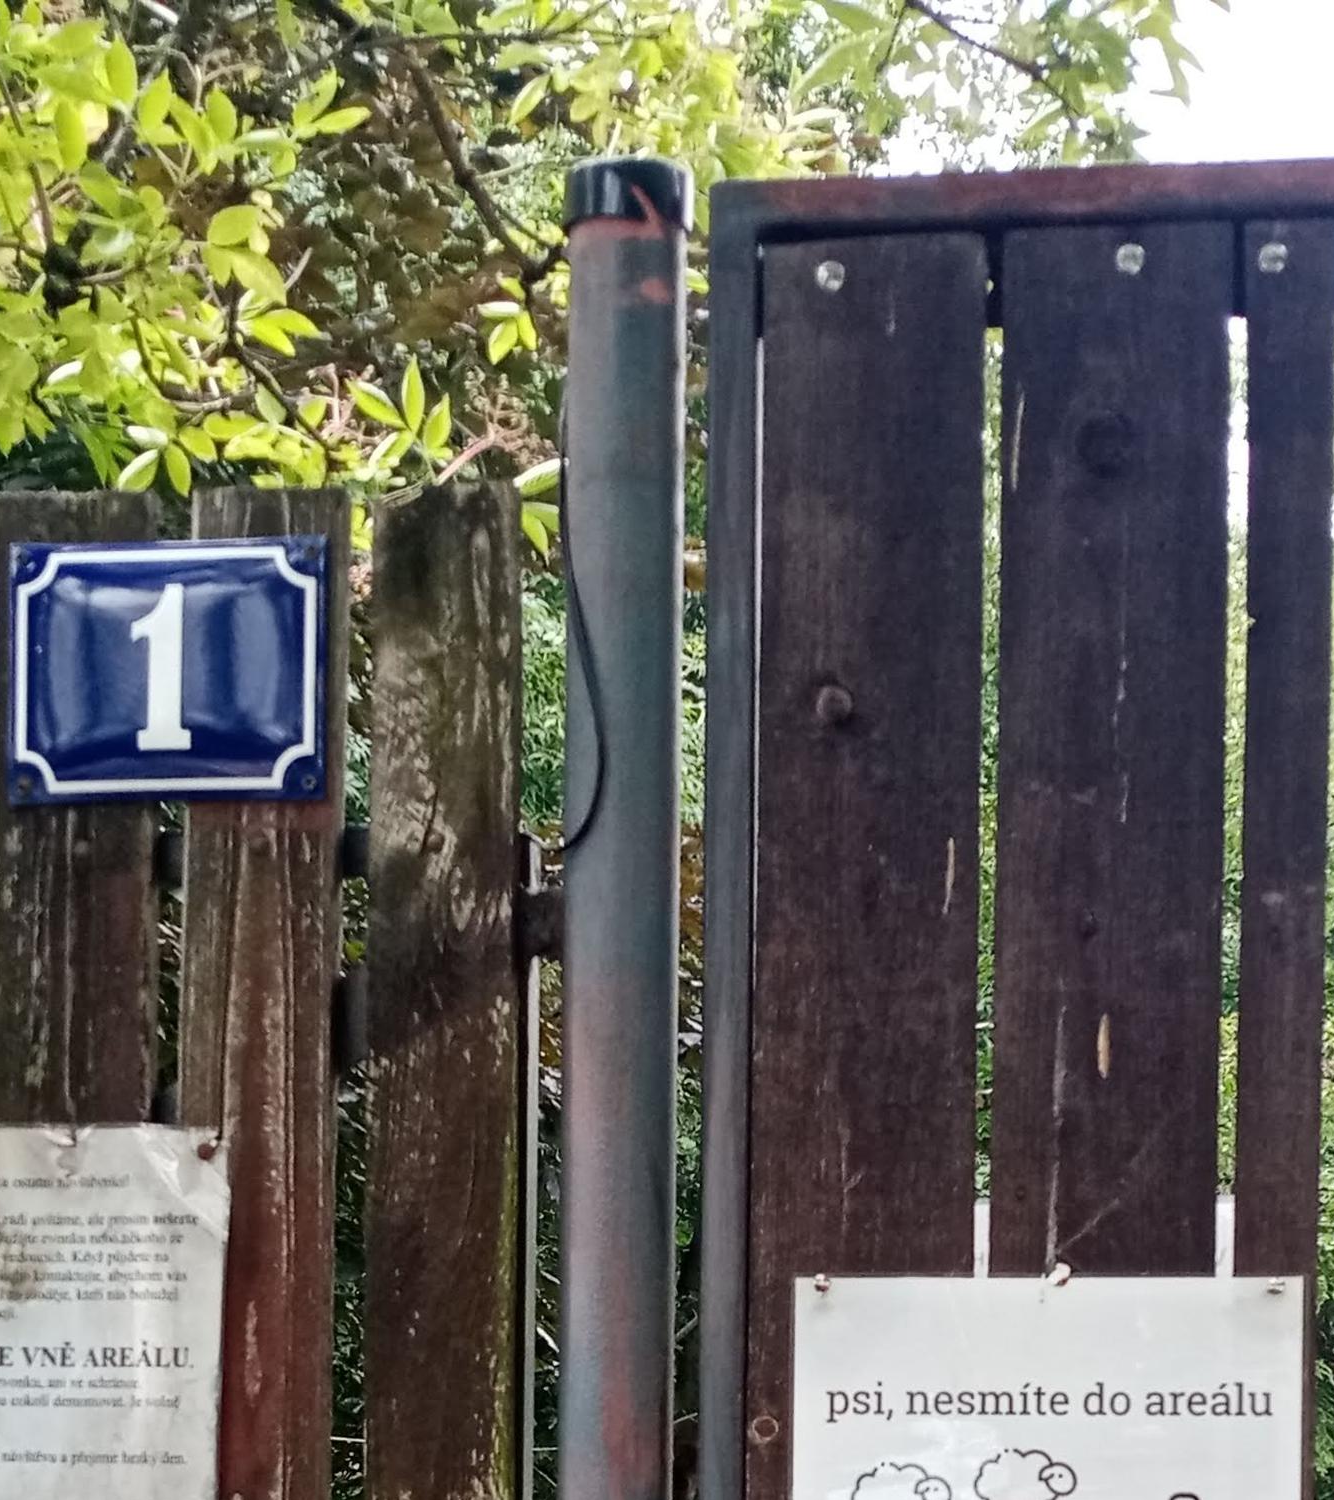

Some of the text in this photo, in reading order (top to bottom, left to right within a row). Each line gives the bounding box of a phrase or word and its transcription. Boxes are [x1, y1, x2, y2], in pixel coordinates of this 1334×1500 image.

[128, 582, 193, 751] 1
[20, 1341, 75, 1368] VNĚ
[82, 1340, 194, 1369] AREÁLU.
[826, 1381, 1273, 1424] psi, nesmíte do areálu
